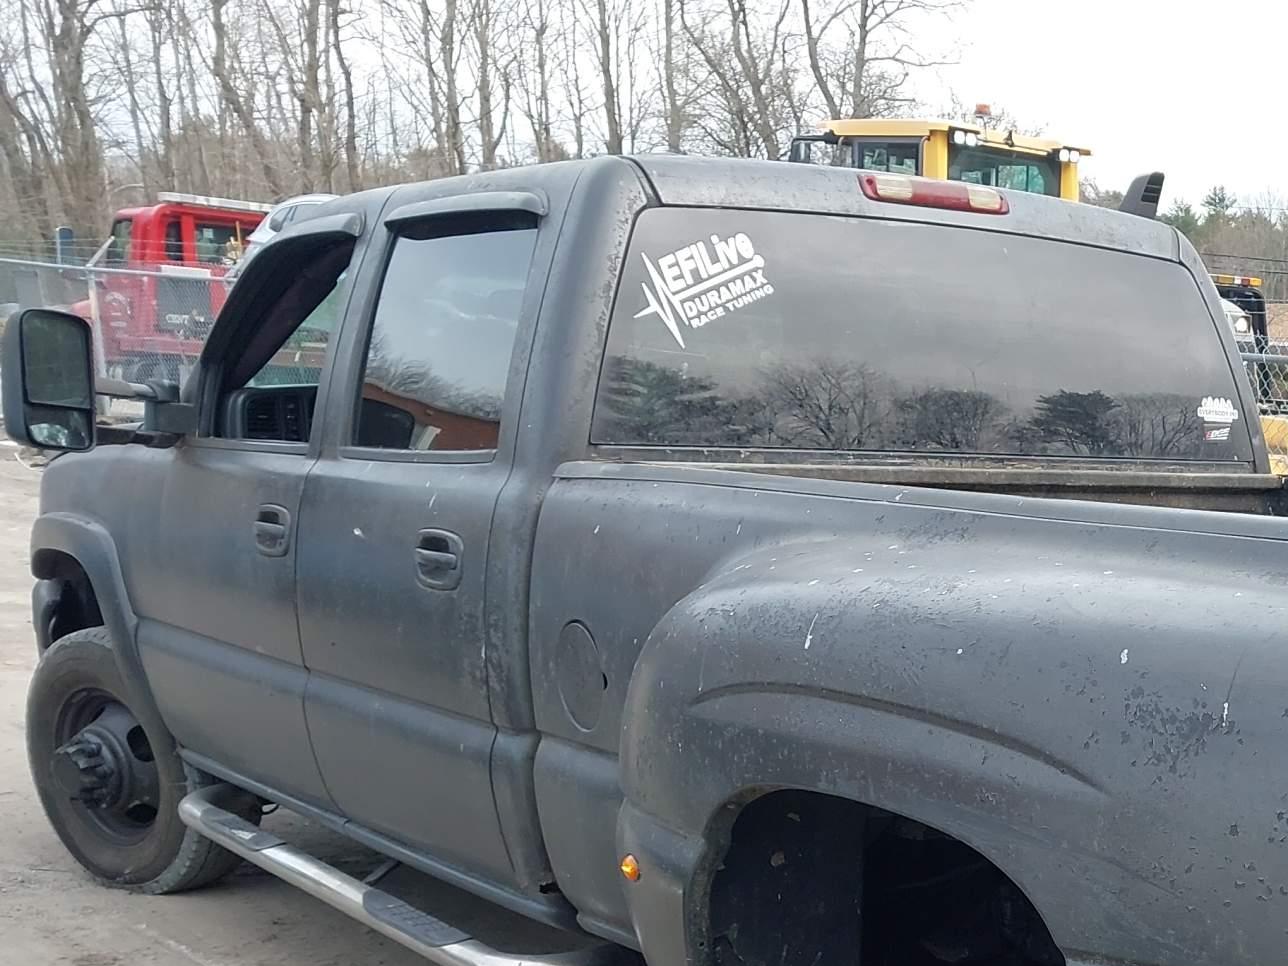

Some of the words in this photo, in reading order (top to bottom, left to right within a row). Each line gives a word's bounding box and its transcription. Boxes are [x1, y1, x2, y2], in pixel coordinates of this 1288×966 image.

[683, 269, 768, 318] DURAMAX
[690, 306, 726, 328] RACE
[725, 284, 774, 311] TUNING
